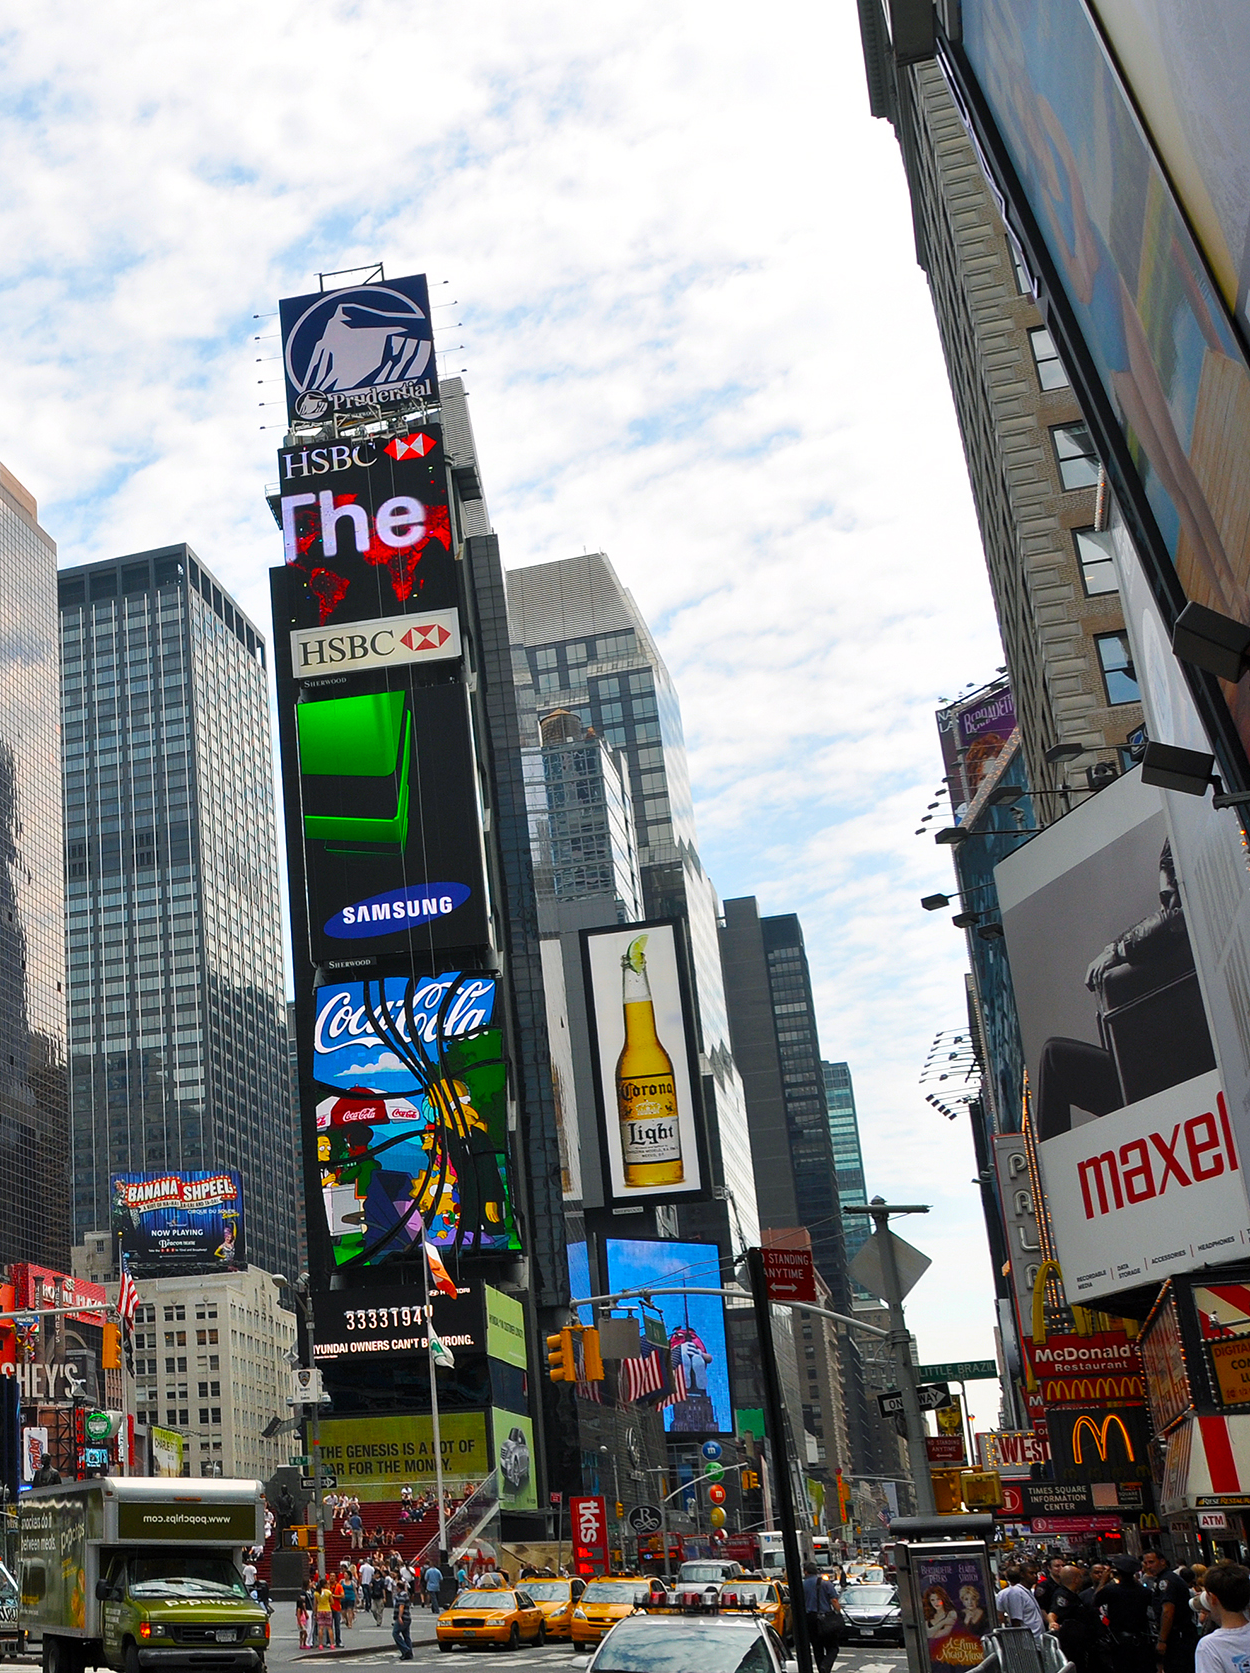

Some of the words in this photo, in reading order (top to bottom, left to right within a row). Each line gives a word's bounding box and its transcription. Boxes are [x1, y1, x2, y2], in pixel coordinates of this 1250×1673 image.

[332, 377, 432, 410] Prudential
[283, 441, 378, 480] HSBC
[299, 629, 397, 667] HSBC
[342, 895, 453, 926] SAMSUNG
[313, 976, 496, 1054] Coca-Cola
[619, 1080, 673, 1102] Corona
[626, 1122, 674, 1146] Light
[127, 1179, 179, 1202] BANANA
[182, 1178, 235, 1201] SHPEEL
[151, 1229, 171, 1237] NOW
[172, 1228, 204, 1236] PLAYING
[768, 1253, 809, 1266] STANDING
[1116, 1263, 1129, 1271] DATA
[1151, 1249, 1187, 1265] ACCESSORIES
[1197, 1235, 1236, 1252] HEADPHONES
[764, 1267, 805, 1279] ANYTIME
[1077, 1282, 1093, 1291] MEDIA
[1118, 1267, 1141, 1279] STORAGE
[350, 1339, 390, 1353] OWNERS
[391, 1338, 420, 1350] CAN'T
[1034, 1343, 1141, 1364] McDonald's
[919, 1365, 955, 1377] LITTLE
[957, 1362, 996, 1375] BRAZIL
[1054, 1359, 1129, 1373] Restaurant
[917, 1391, 939, 1404] WAY
[319, 1445, 343, 1459] THE
[346, 1443, 400, 1459] GENESIS
[403, 1442, 416, 1455] IS
[418, 1441, 429, 1455] A
[458, 1439, 476, 1453] OF
[349, 1461, 373, 1475] FOR
[377, 1459, 400, 1474] THE
[1027, 1486, 1054, 1495] TIMES
[1054, 1485, 1088, 1494] SQUARE
[1030, 1493, 1088, 1504] INFORMATION
[1044, 1502, 1076, 1512] CENTER
[578, 1500, 600, 1545] tkts
[1171, 1521, 1190, 1532] ATM
[1201, 1514, 1225, 1526] ATM
[60, 1523, 86, 1557] popchips
